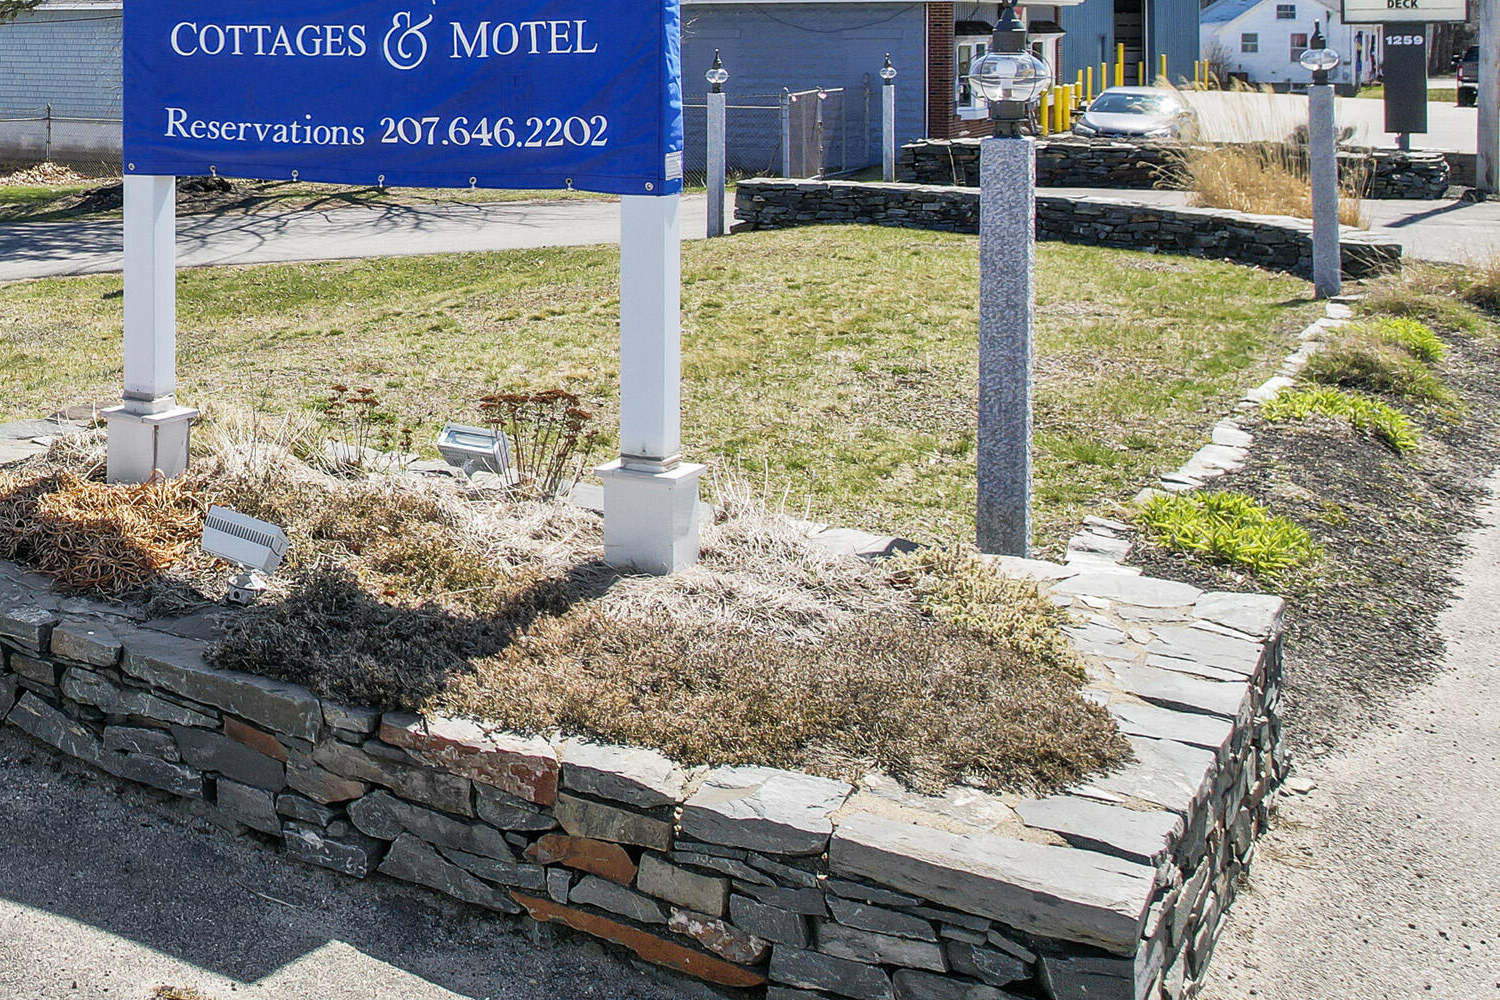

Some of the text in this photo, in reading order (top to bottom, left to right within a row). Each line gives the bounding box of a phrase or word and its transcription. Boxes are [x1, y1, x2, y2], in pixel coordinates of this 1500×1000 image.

[1387, 0, 1418, 9] DECK
[171, 12, 598, 70] COTTAGES & MOTEL
[1386, 35, 1424, 46] 1259
[165, 108, 608, 148] Reservations 207.646.2202
